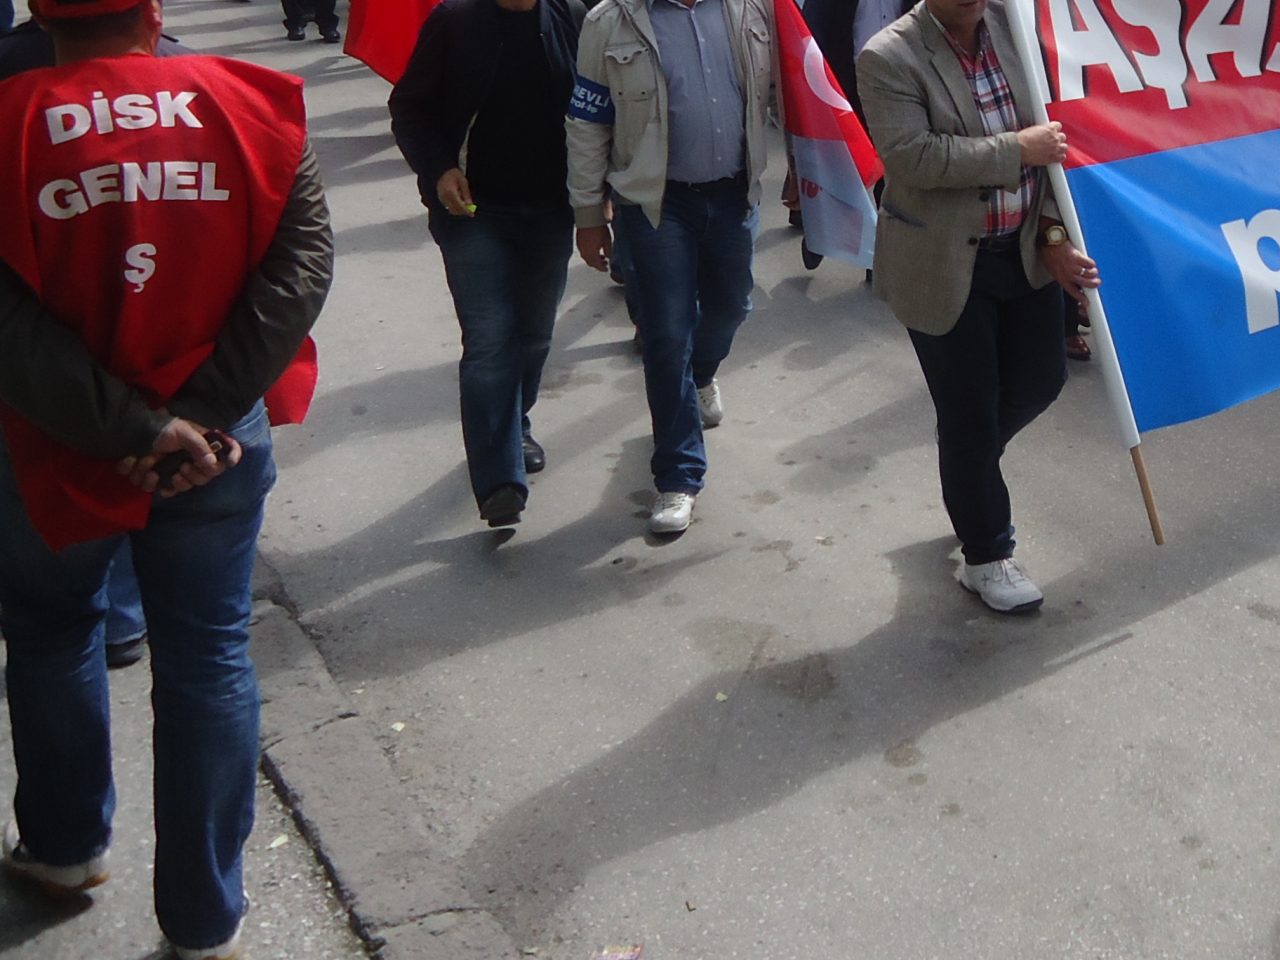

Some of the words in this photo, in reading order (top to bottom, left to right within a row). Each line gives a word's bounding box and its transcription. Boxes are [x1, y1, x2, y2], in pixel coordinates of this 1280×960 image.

[45, 90, 204, 146] DİSK
[38, 161, 230, 220] GENEL
[124, 243, 157, 294] Ş
